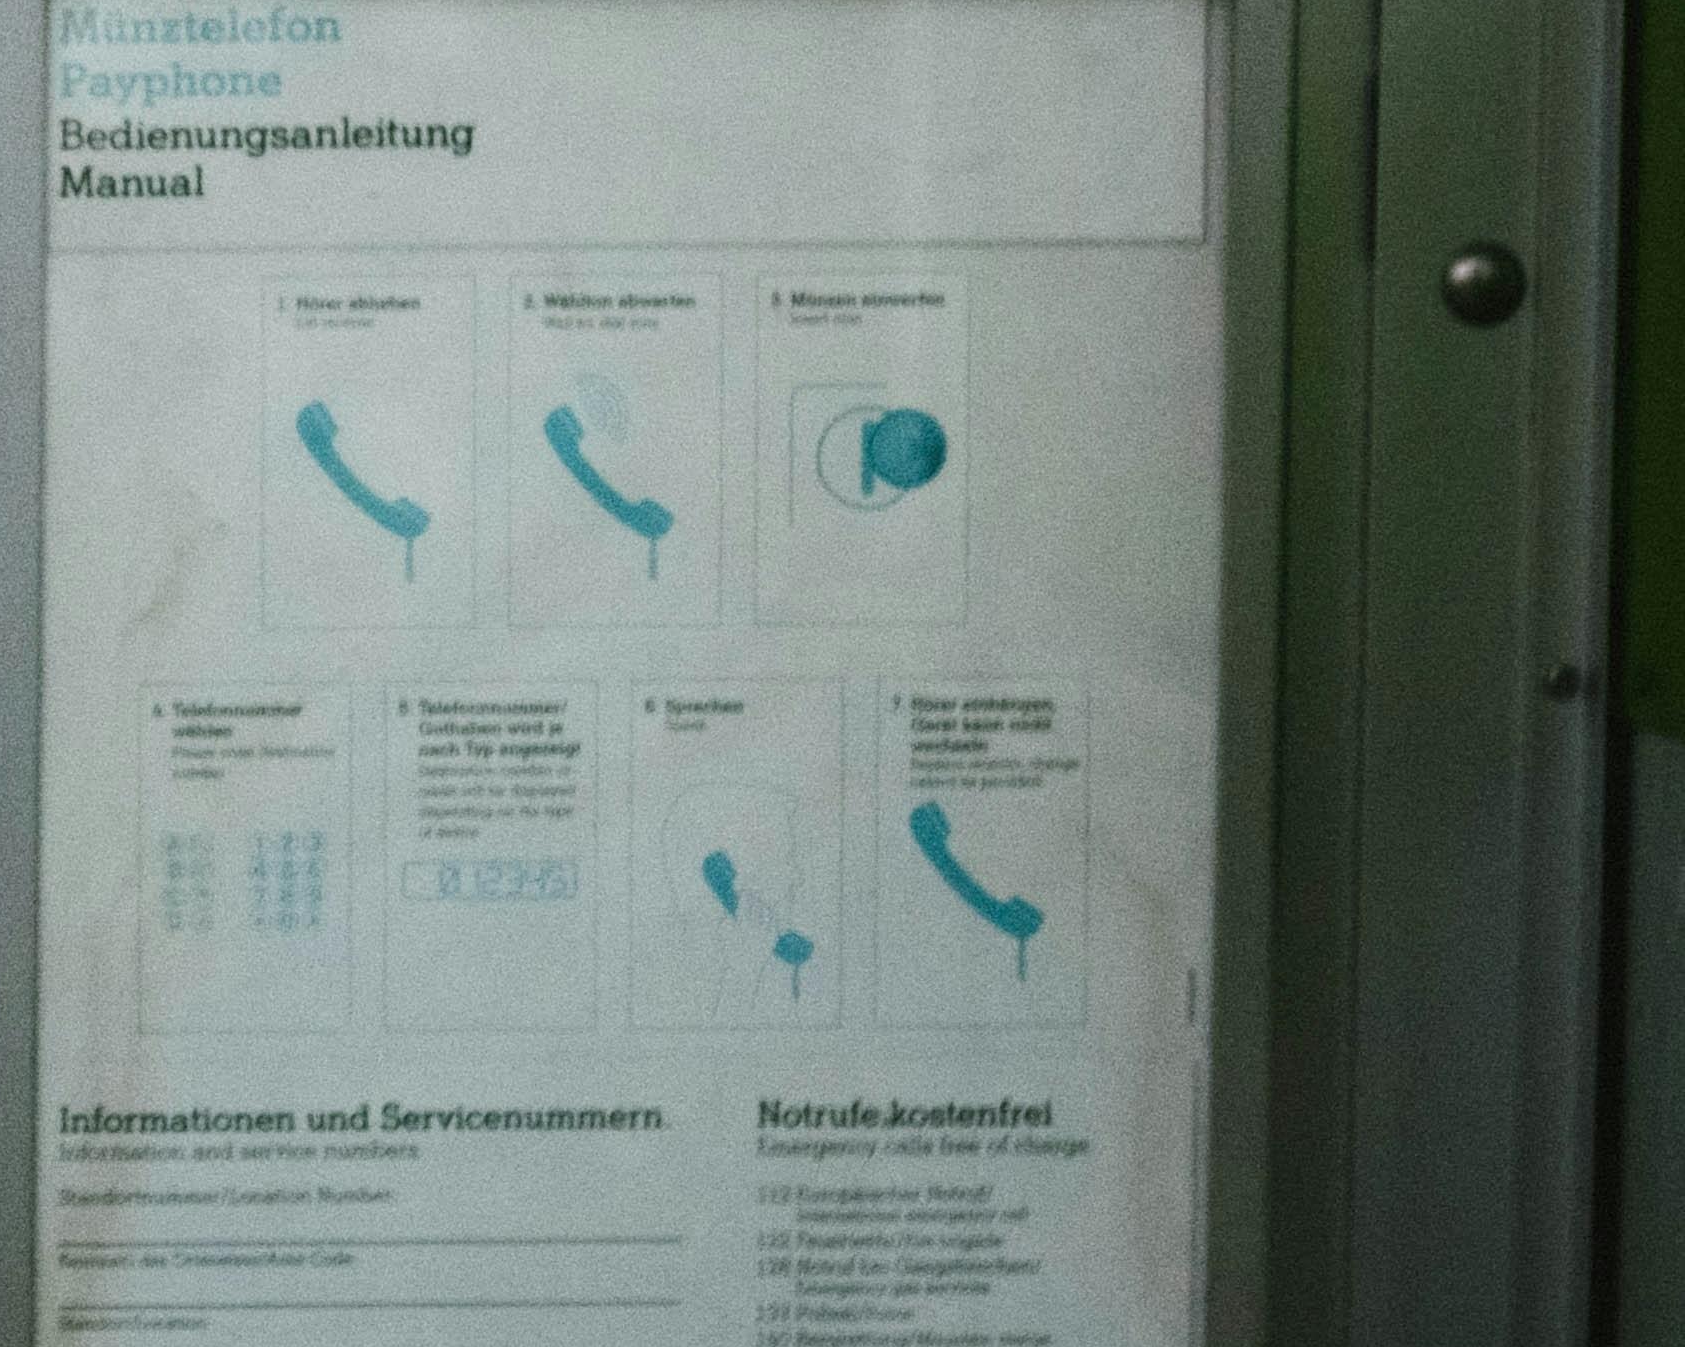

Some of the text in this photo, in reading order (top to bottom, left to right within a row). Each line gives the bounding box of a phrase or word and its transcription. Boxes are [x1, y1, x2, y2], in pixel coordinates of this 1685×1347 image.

[58, 5, 343, 46] Münztelefon
[58, 60, 284, 107] Payphone
[58, 118, 476, 157] Bedienungsanleitung
[58, 164, 206, 199] Manual
[58, 1101, 664, 1135] Informationen und Servicenummern
[757, 1098, 1053, 1130] Notrufe kostenfrei
